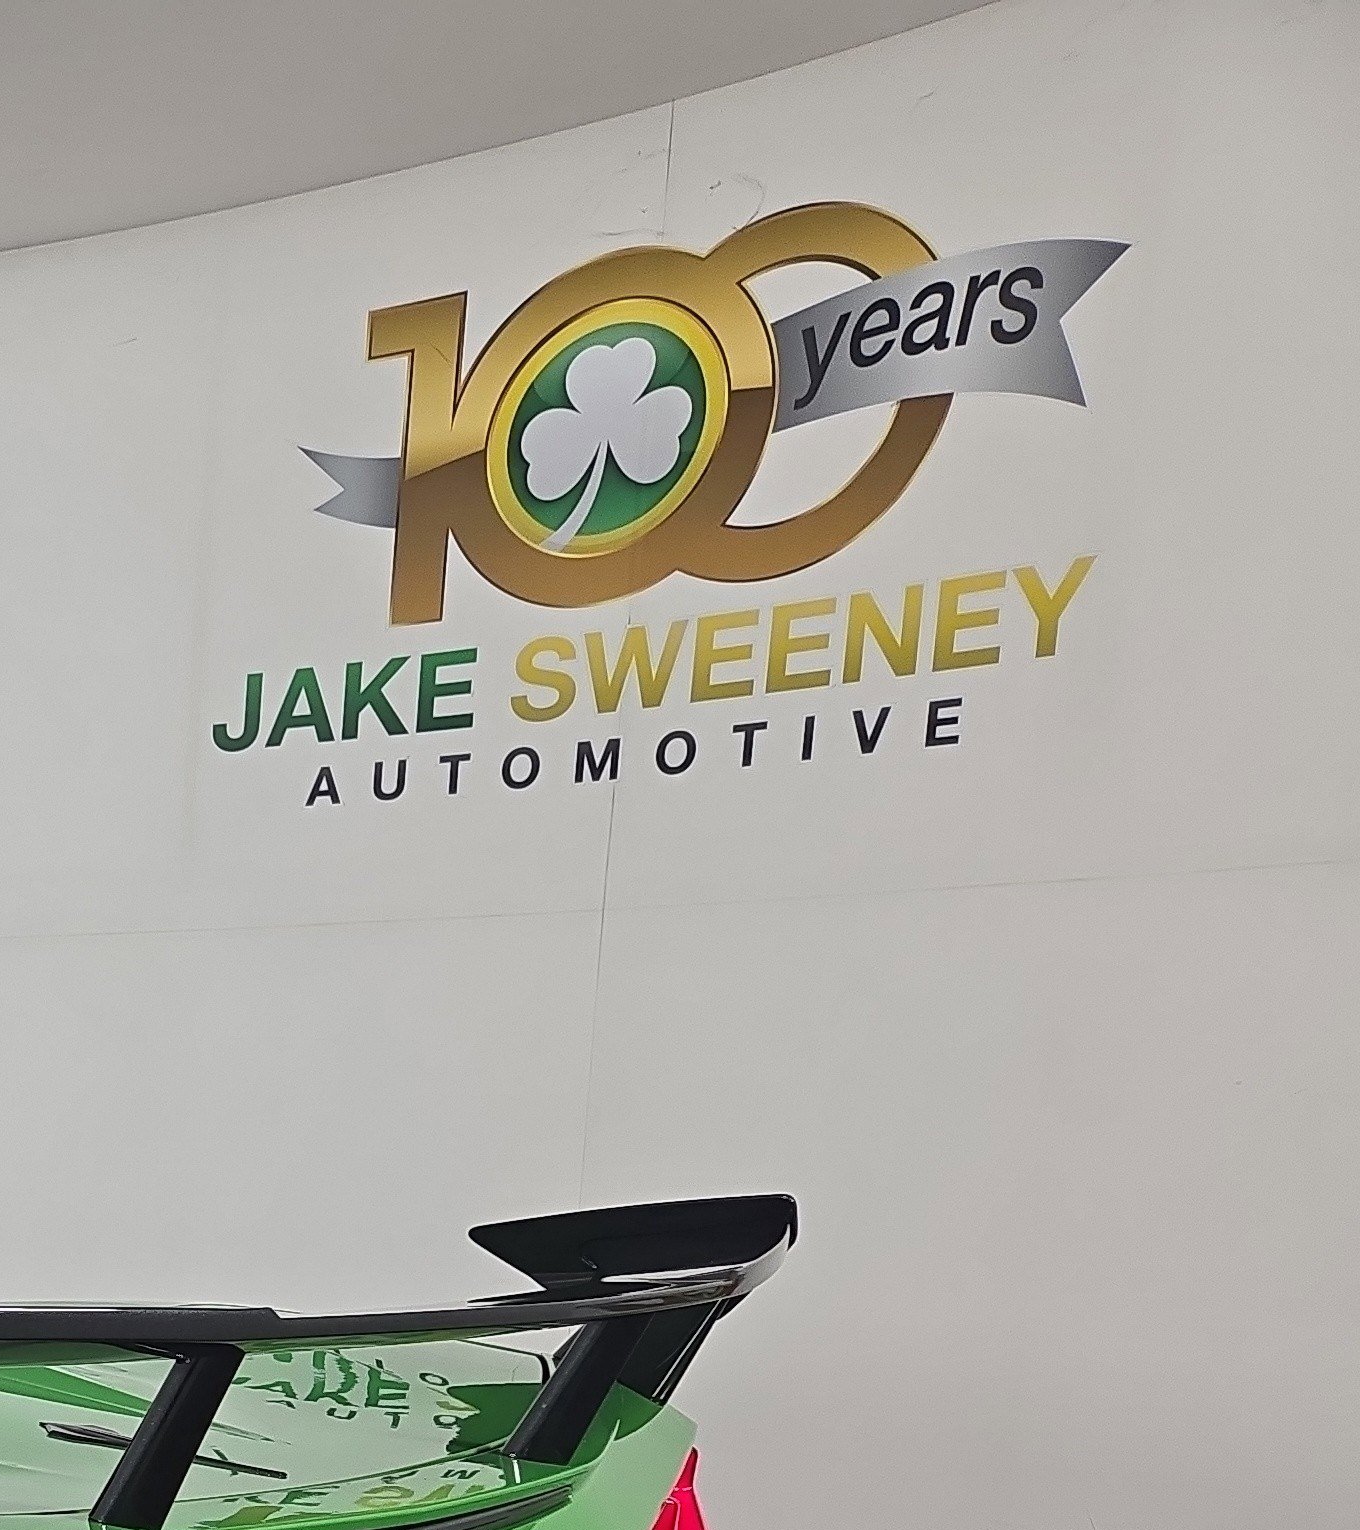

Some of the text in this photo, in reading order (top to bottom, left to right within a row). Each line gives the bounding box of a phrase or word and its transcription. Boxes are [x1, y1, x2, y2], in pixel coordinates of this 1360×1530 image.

[793, 264, 1045, 411] years
[211, 555, 1098, 752] JAKE SWEENEY
[304, 696, 966, 808] AUTOMOTIVE
